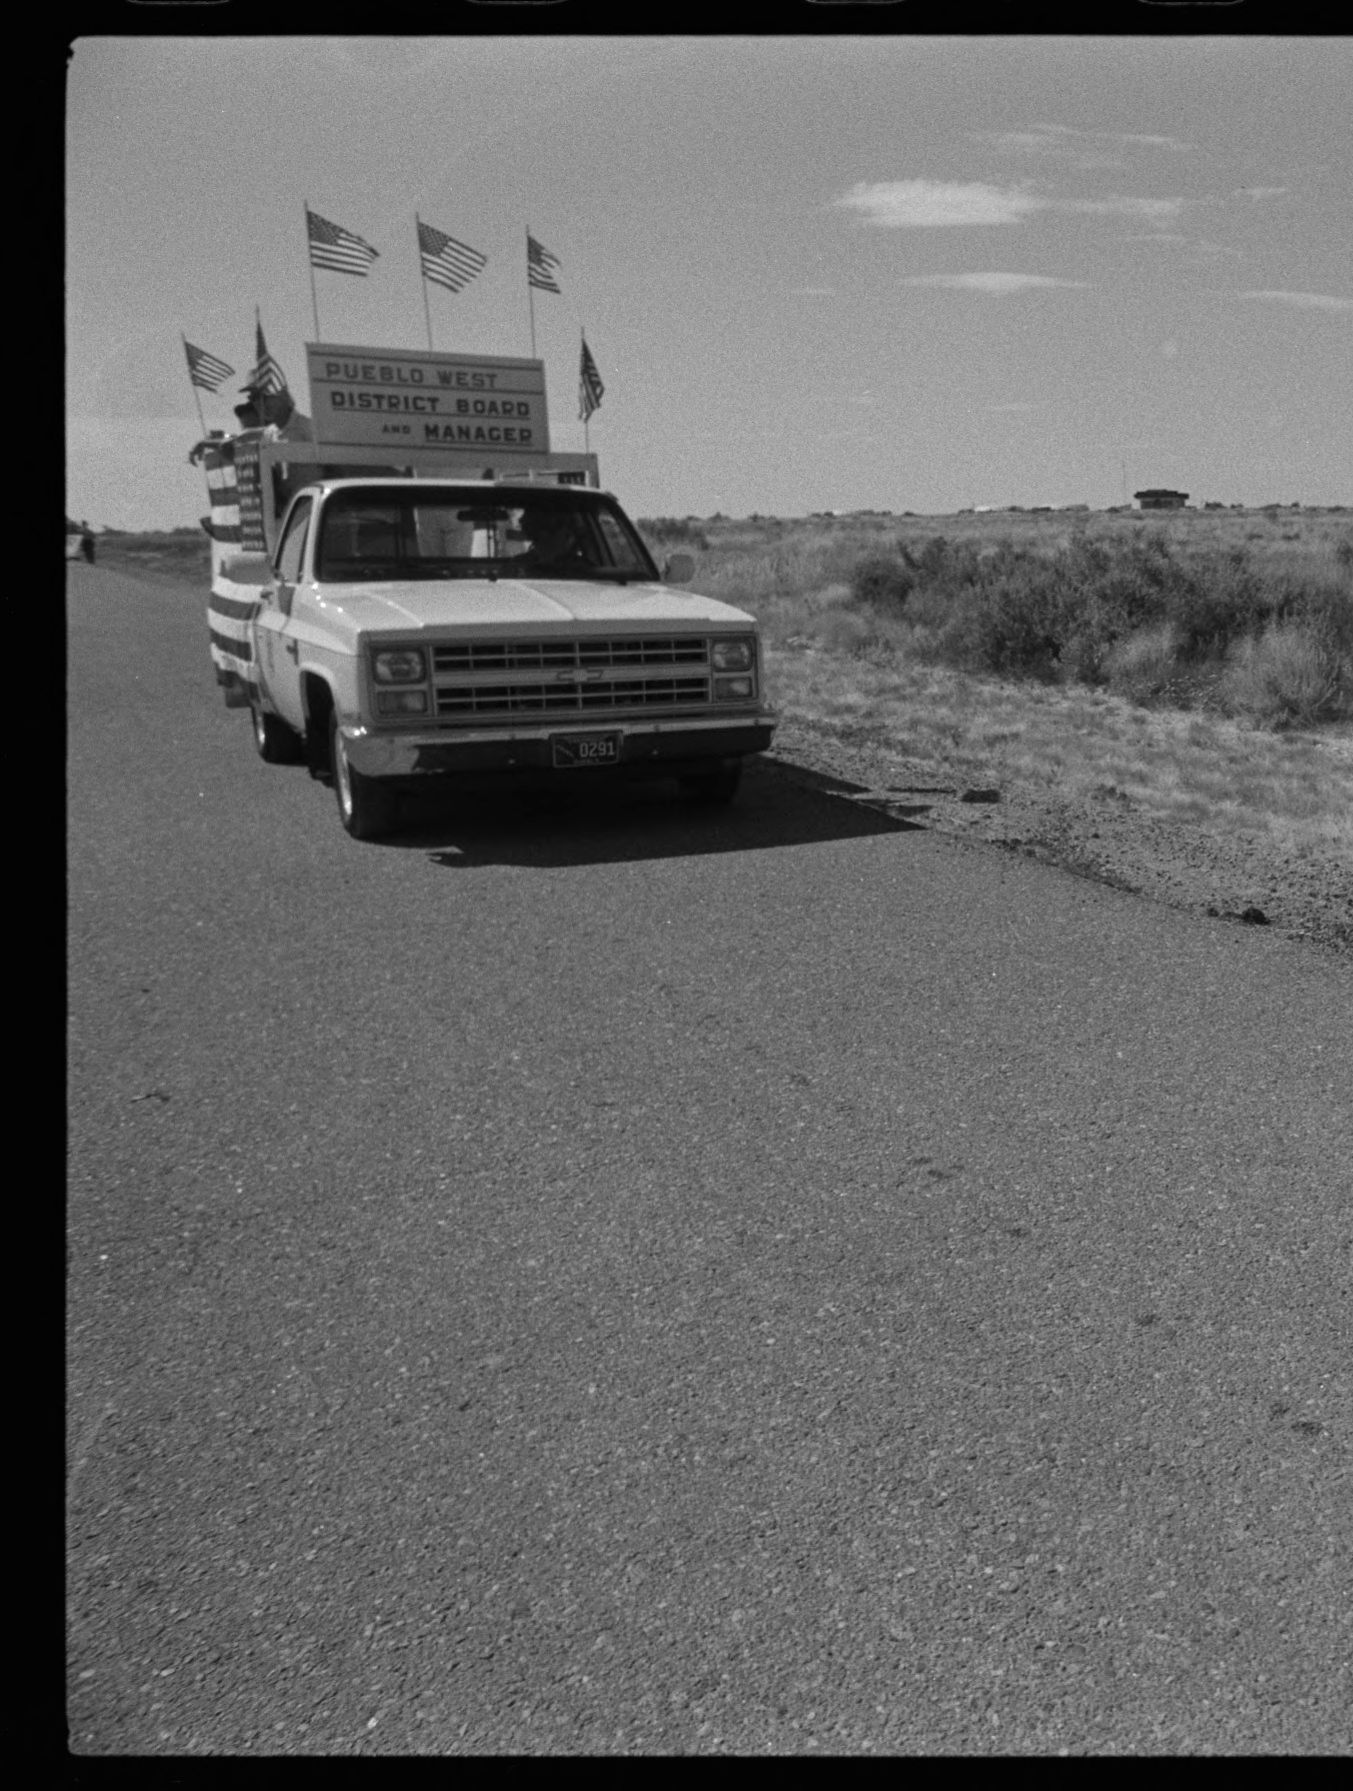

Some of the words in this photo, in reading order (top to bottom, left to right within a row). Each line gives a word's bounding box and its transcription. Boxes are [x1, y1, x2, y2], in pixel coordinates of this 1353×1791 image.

[325, 362, 424, 384] PUEBLO
[436, 370, 498, 389] WEST
[331, 391, 440, 412] DISTRICT
[456, 399, 530, 416] BOARD
[382, 424, 411, 435] AND
[424, 423, 532, 442] MANAGER
[579, 741, 615, 758] 0291
